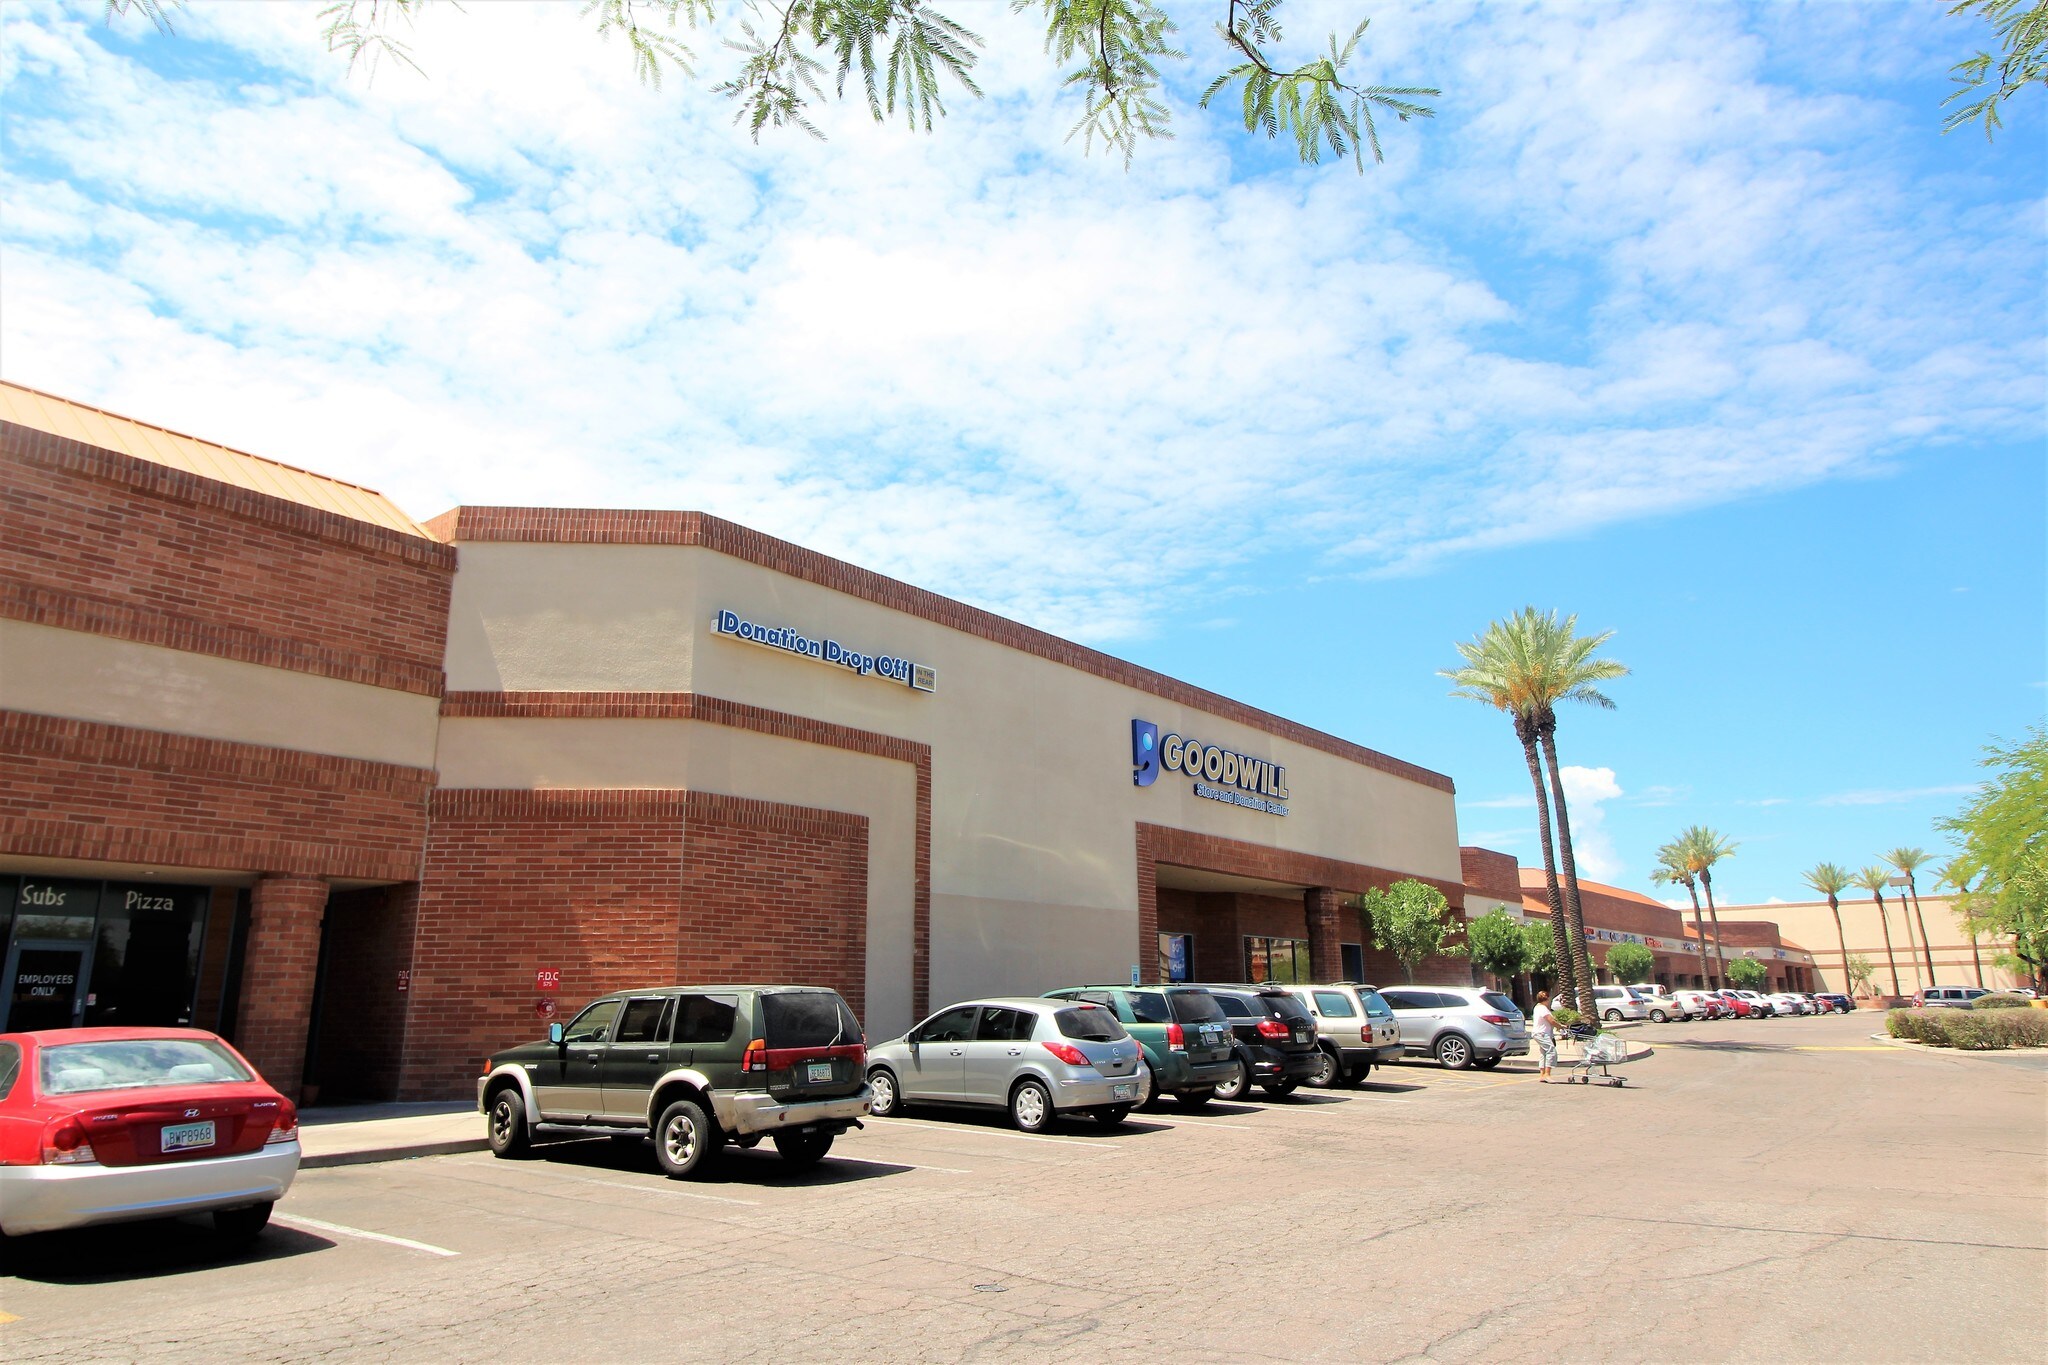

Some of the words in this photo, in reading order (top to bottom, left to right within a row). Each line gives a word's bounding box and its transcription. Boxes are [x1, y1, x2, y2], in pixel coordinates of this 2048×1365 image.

[718, 609, 821, 660] Donation
[822, 639, 874, 675] Drop
[874, 655, 909, 680] Off
[917, 677, 933, 686] REAR
[1160, 733, 1289, 800] GOODWILL
[1194, 782, 1221, 800] Store
[1219, 790, 1234, 804] and
[1234, 792, 1267, 813] Donation
[1266, 800, 1290, 817] Center
[21, 884, 67, 906] Subs
[125, 890, 175, 911] Pizza
[18, 974, 74, 985] EMPLOYEES
[31, 986, 56, 996] ONLY
[168, 1127, 212, 1146] BWP8968
